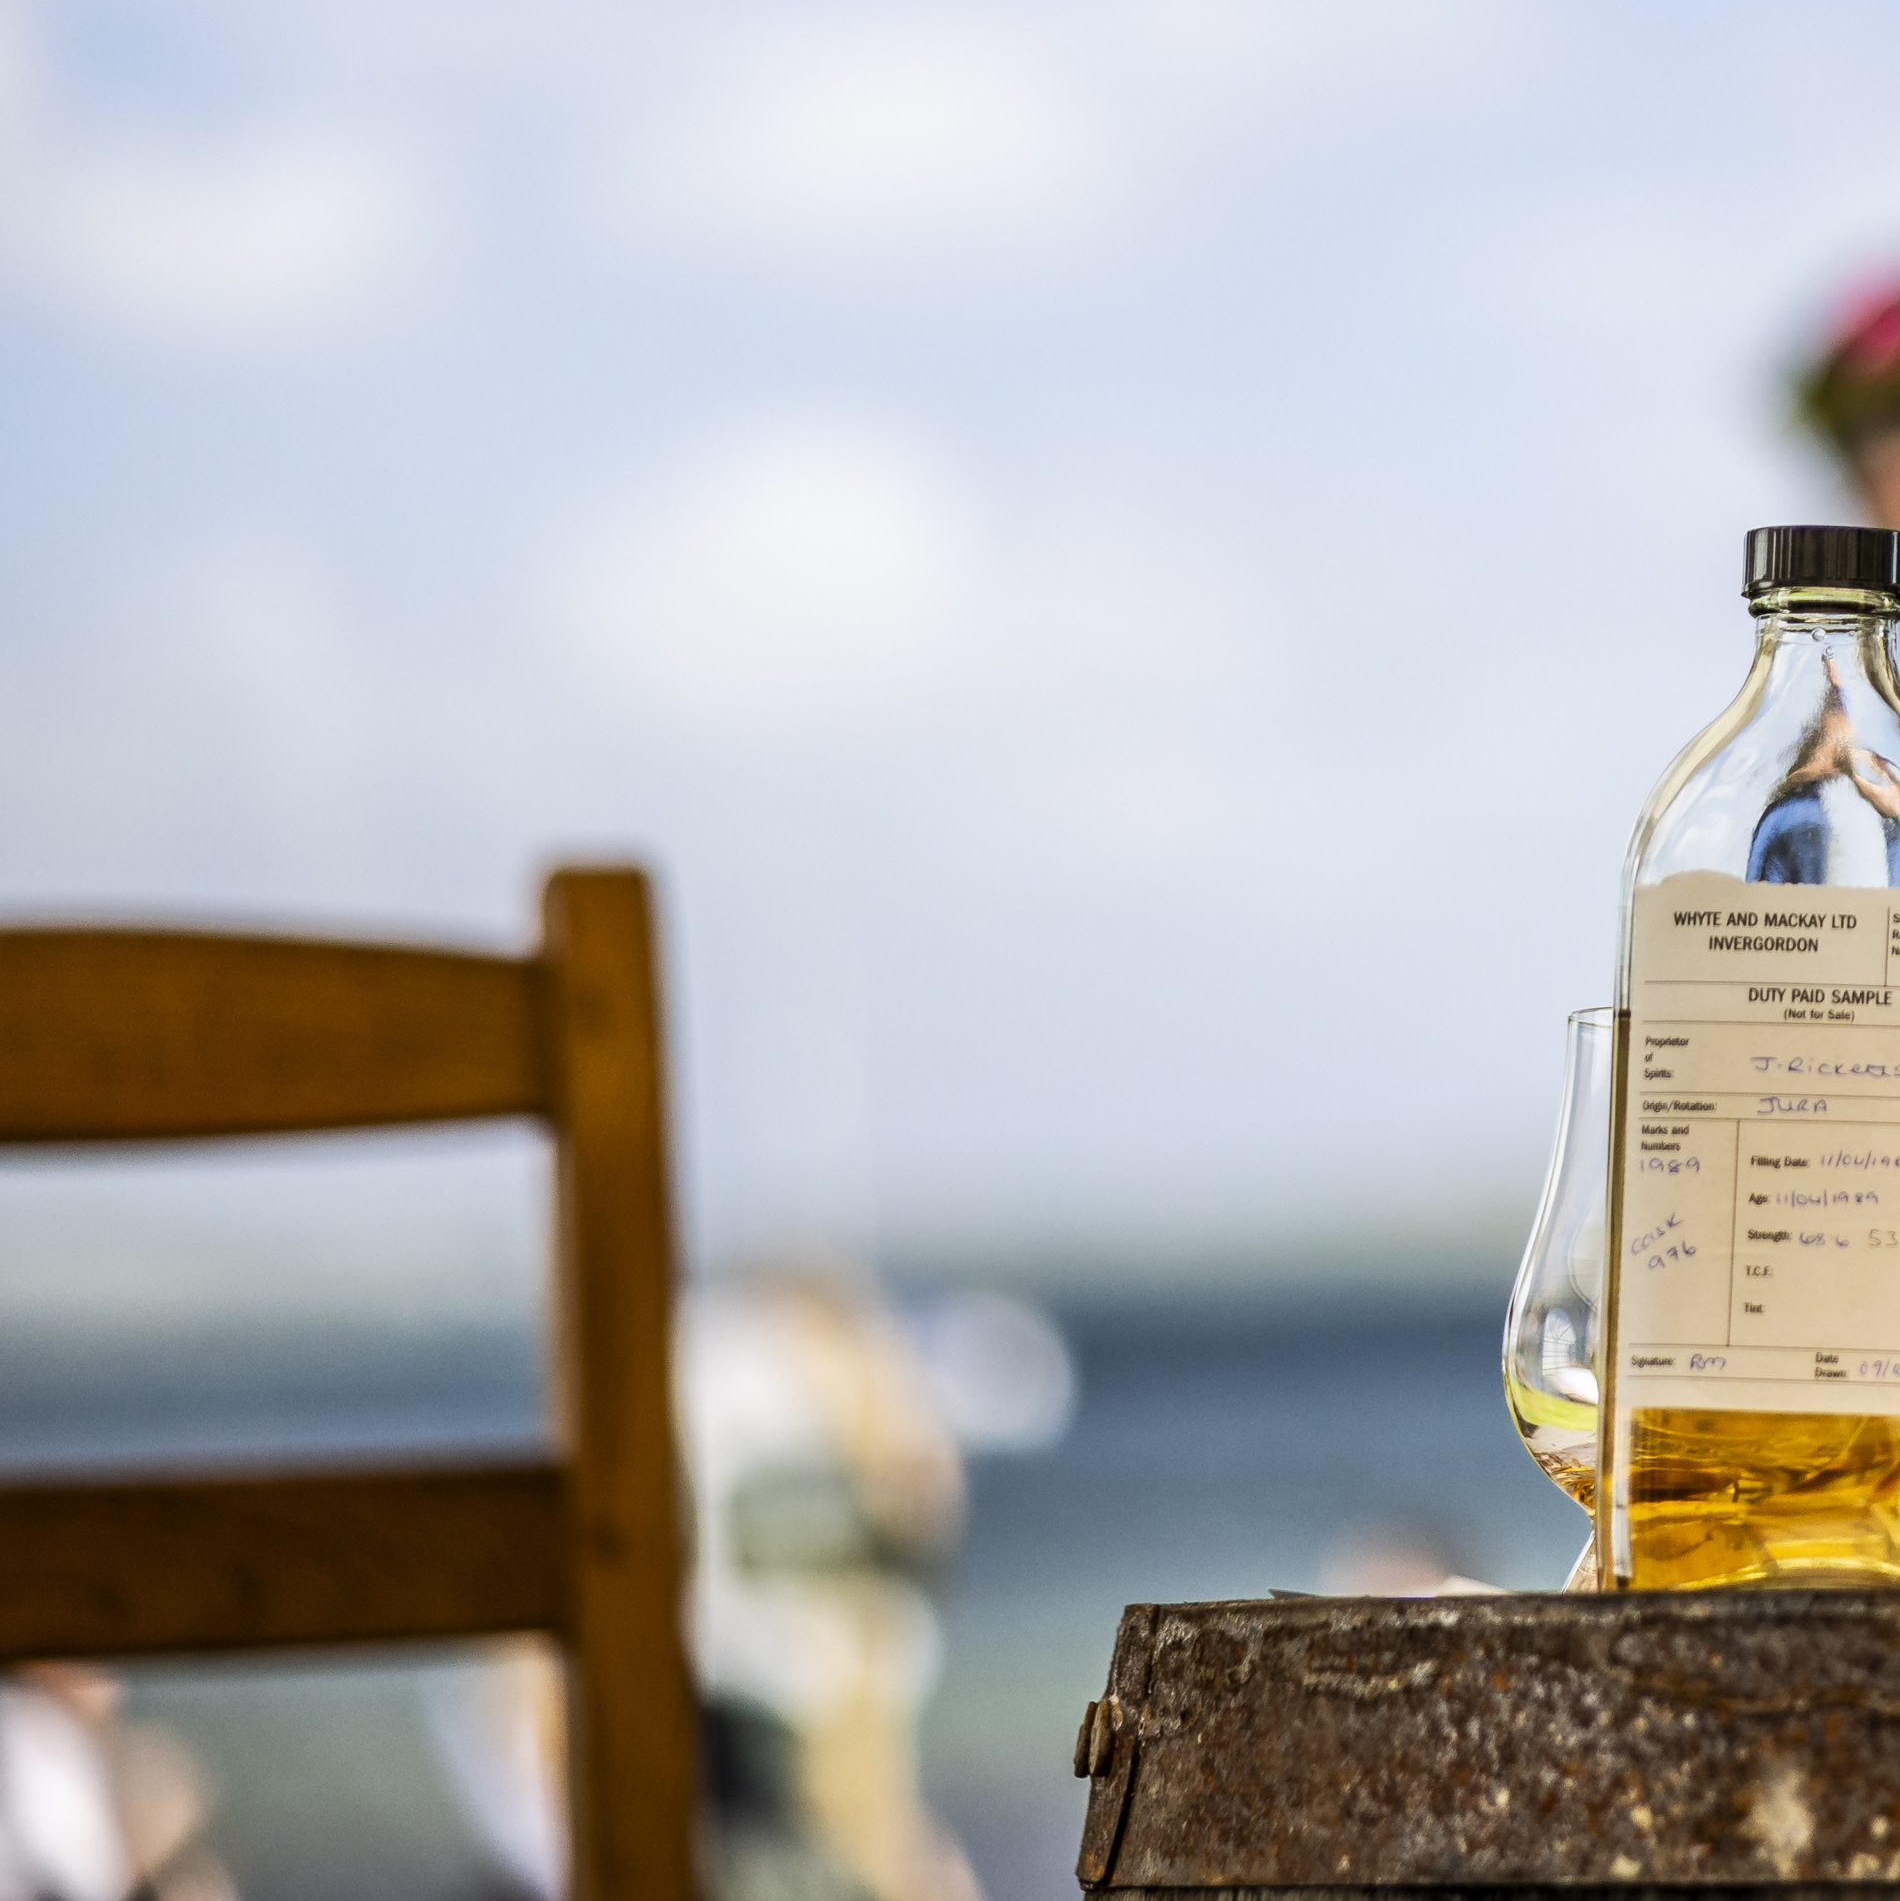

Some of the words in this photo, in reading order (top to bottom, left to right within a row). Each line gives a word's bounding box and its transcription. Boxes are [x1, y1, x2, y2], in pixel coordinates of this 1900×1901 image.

[1674, 911, 1722, 927] WHYTE
[1726, 912, 1759, 927] AND
[1764, 913, 1826, 929] MACKAY
[1832, 914, 1857, 929] LTD
[1709, 936, 1819, 952] INVERGORDON
[1749, 988, 1785, 1003] DUTY
[1791, 989, 1824, 1003] PAID
[1832, 990, 1893, 1005] SAMPLE
[1784, 1009, 1806, 1021] (Not
[1810, 1009, 1824, 1020] for
[1828, 1009, 1855, 1022] Sale)
[1645, 1036, 1690, 1048] Proprietor
[1645, 1051, 1653, 1062] of
[1644, 1067, 1674, 1080] Spirits:
[1642, 1100, 1717, 1113] Origin/Rotation:
[1757, 1097, 1827, 1115] JURA
[1642, 1124, 1668, 1135] Marks
[1671, 1125, 1689, 1135] and
[1641, 1140, 1681, 1151] Numbers
[1751, 1155, 1780, 1170] Filling
[1785, 1156, 1810, 1167] Date:
[1749, 1193, 1770, 1205] Age:
[1748, 1229, 1792, 1242] Strength:
[1631, 1355, 1676, 1367] Signature:
[1815, 1352, 1839, 1363] Date
[1815, 1367, 1849, 1378] Drawn:
